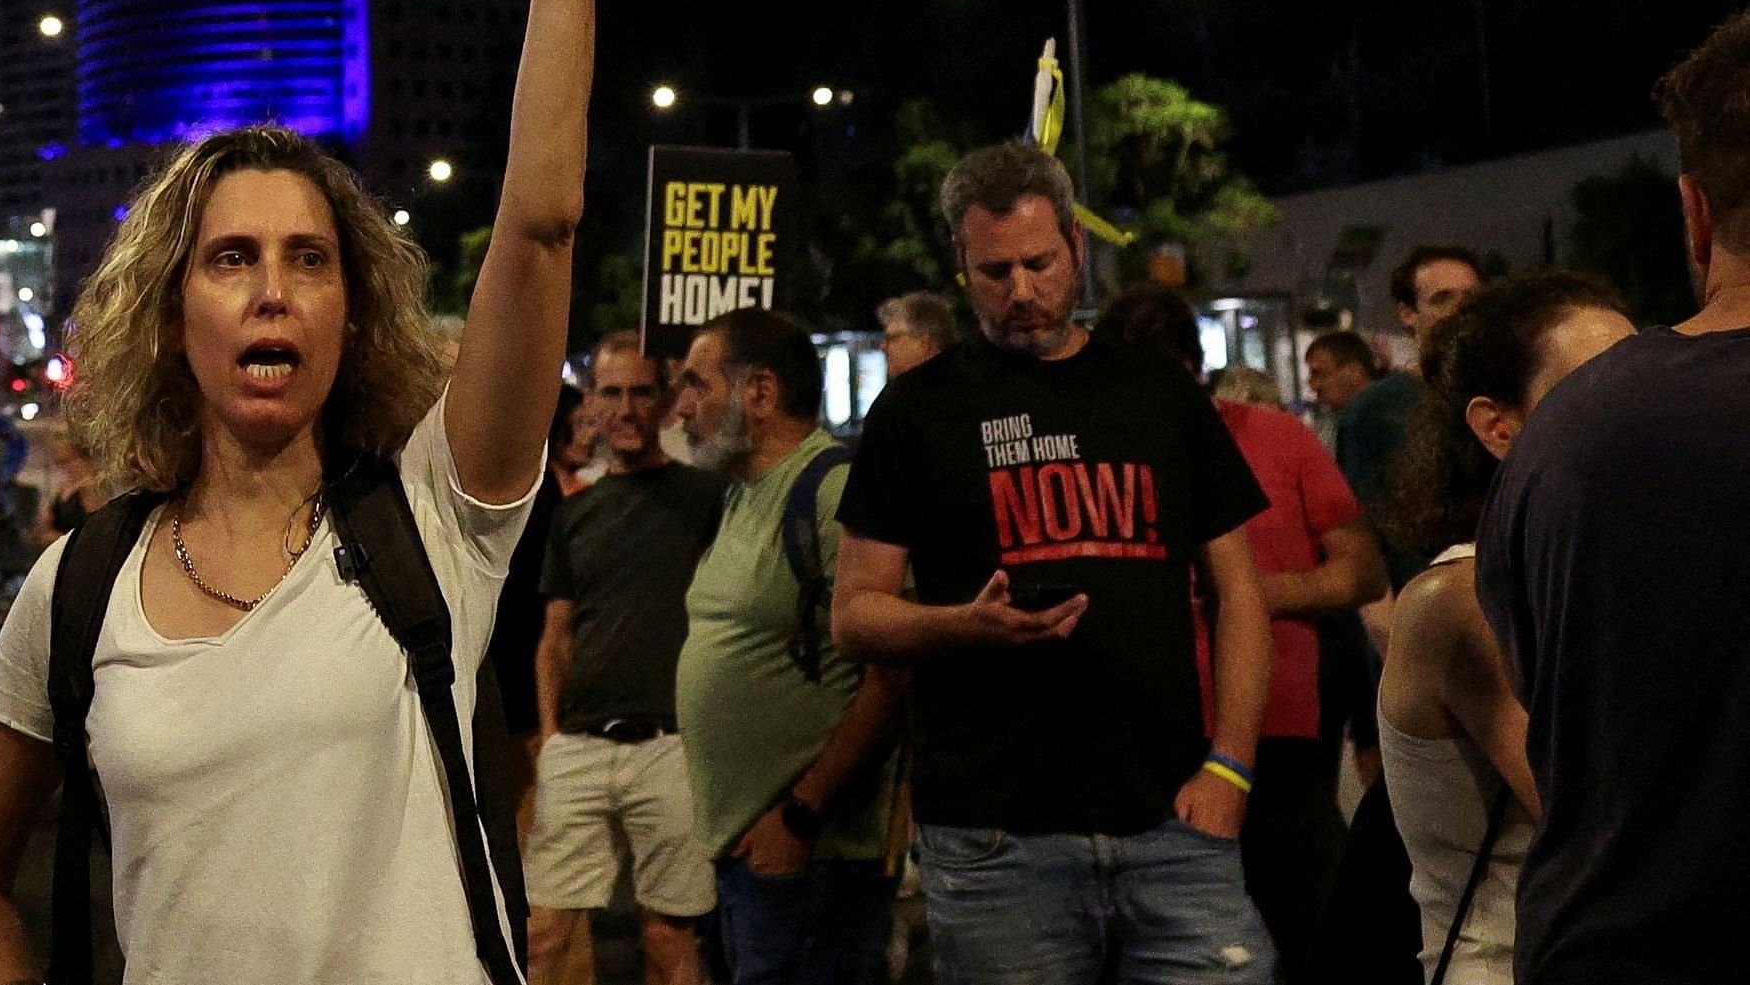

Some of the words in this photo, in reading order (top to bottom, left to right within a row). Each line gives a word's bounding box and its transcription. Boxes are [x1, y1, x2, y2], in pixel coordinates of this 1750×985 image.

[664, 181, 726, 229] GET
[730, 184, 779, 231] MY
[662, 229, 776, 275] PEOPLE
[981, 413, 1033, 445] BRING
[985, 439, 1031, 467] THEM
[1032, 434, 1081, 462] HOME
[989, 462, 1159, 546] NOW!
